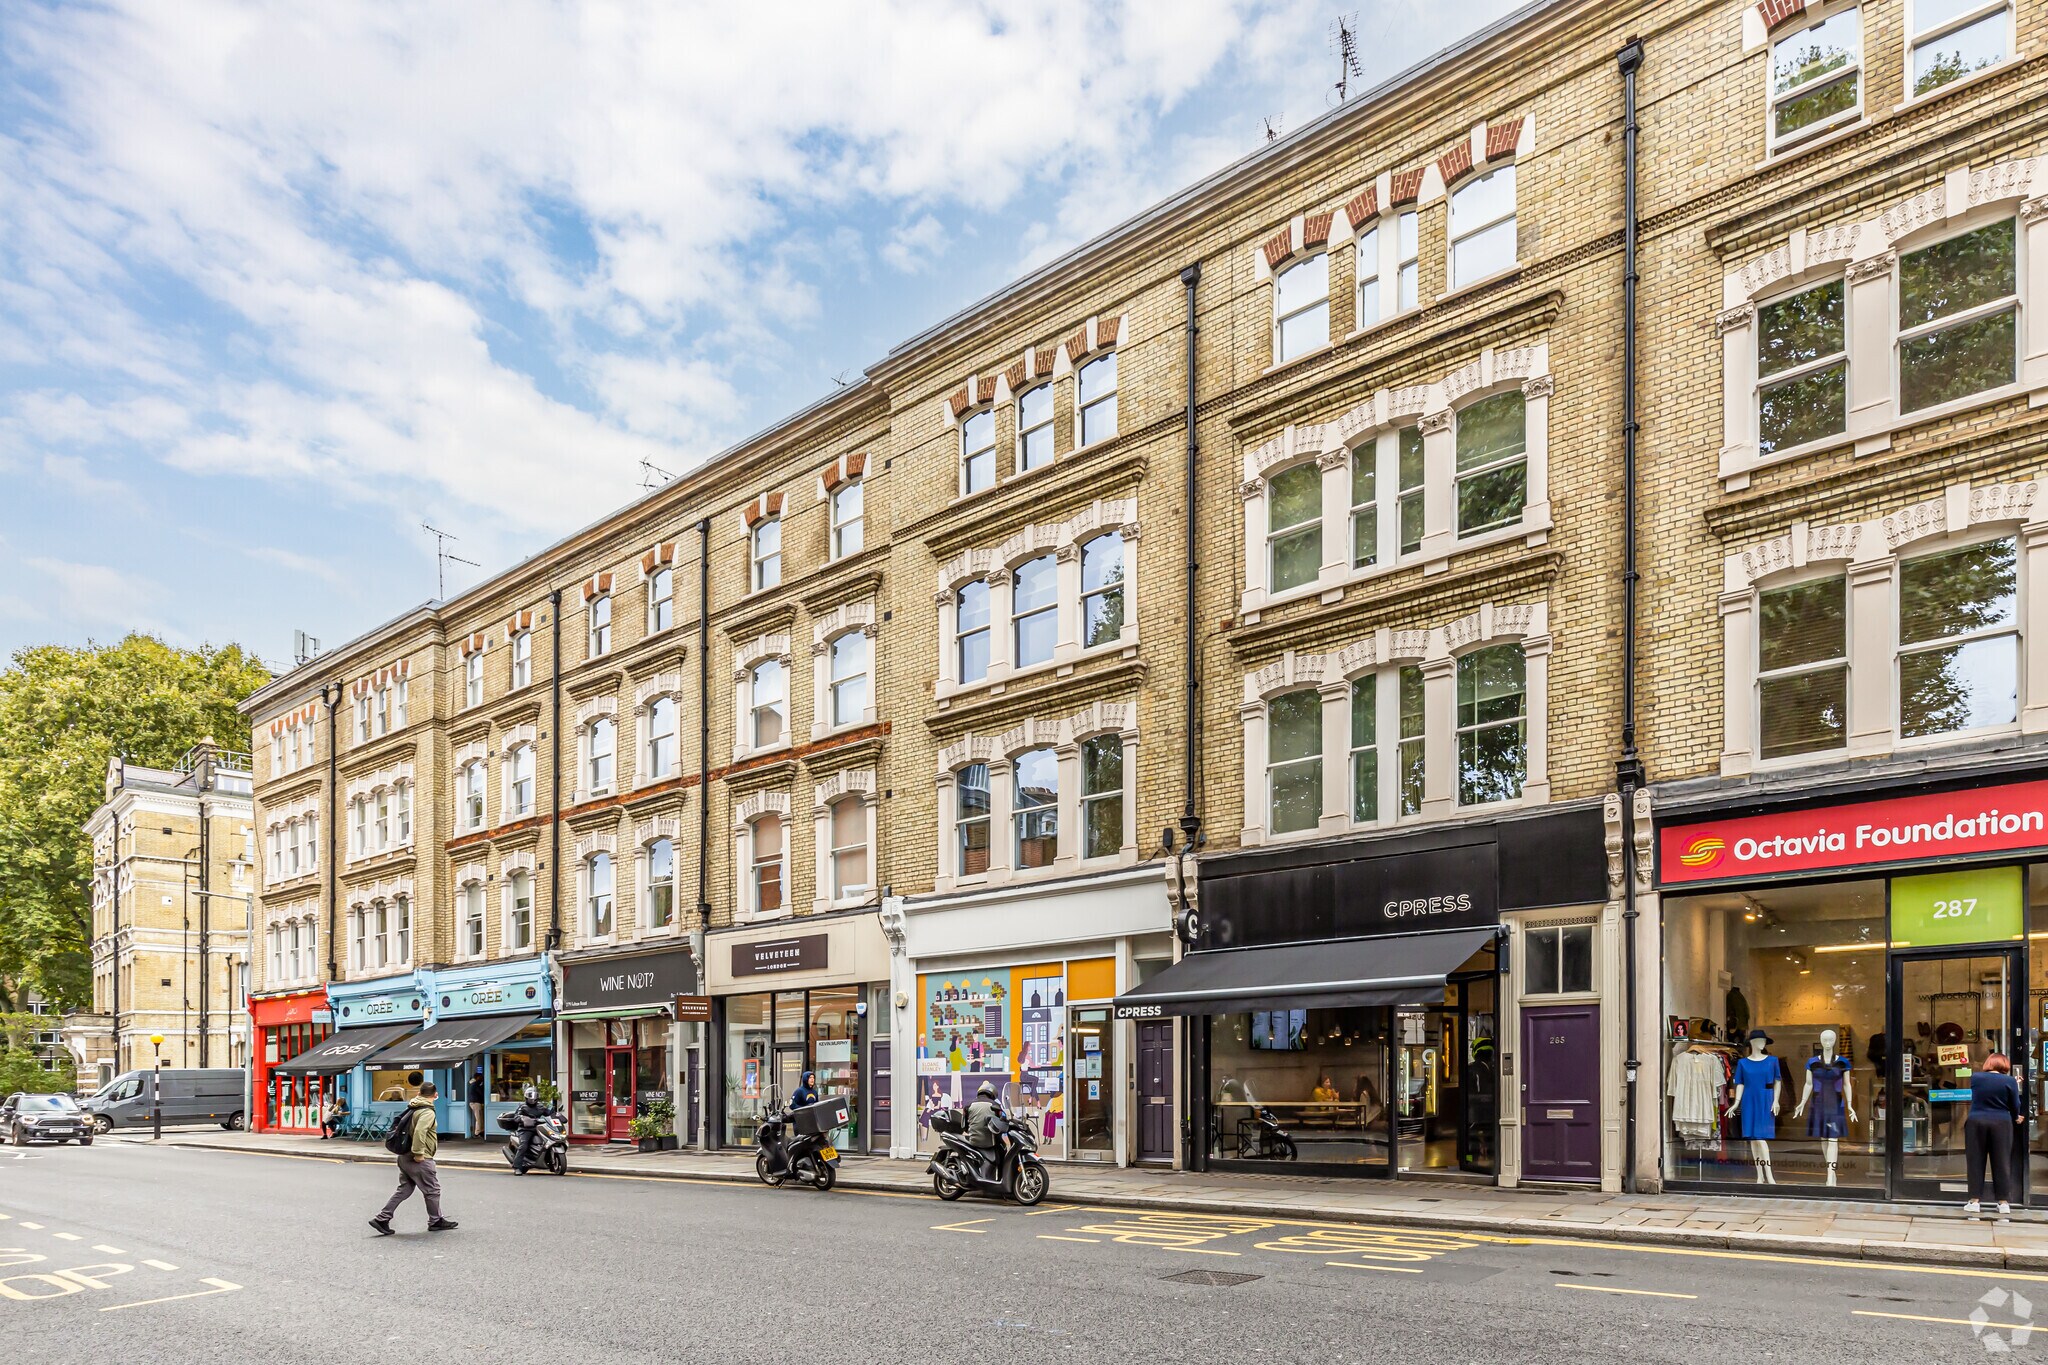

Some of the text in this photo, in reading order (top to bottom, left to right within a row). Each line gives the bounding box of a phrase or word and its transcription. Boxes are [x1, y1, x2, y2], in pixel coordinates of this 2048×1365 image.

[1733, 809, 2044, 861] Octavia Foundation
[1383, 893, 1472, 919] CPRESS
[1932, 898, 1978, 919] 287
[755, 948, 800, 961] VELVETEEN
[600, 972, 654, 992] WINE NOT?
[470, 988, 502, 1005] ORÉE
[366, 1001, 393, 1016] ORÉE
[1117, 1006, 1162, 1018] CPRESS
[1941, 1052, 1965, 1062] OPEN
[839, 1112, 846, 1120] L
[1064, 1215, 1479, 1262] BUS STOP
